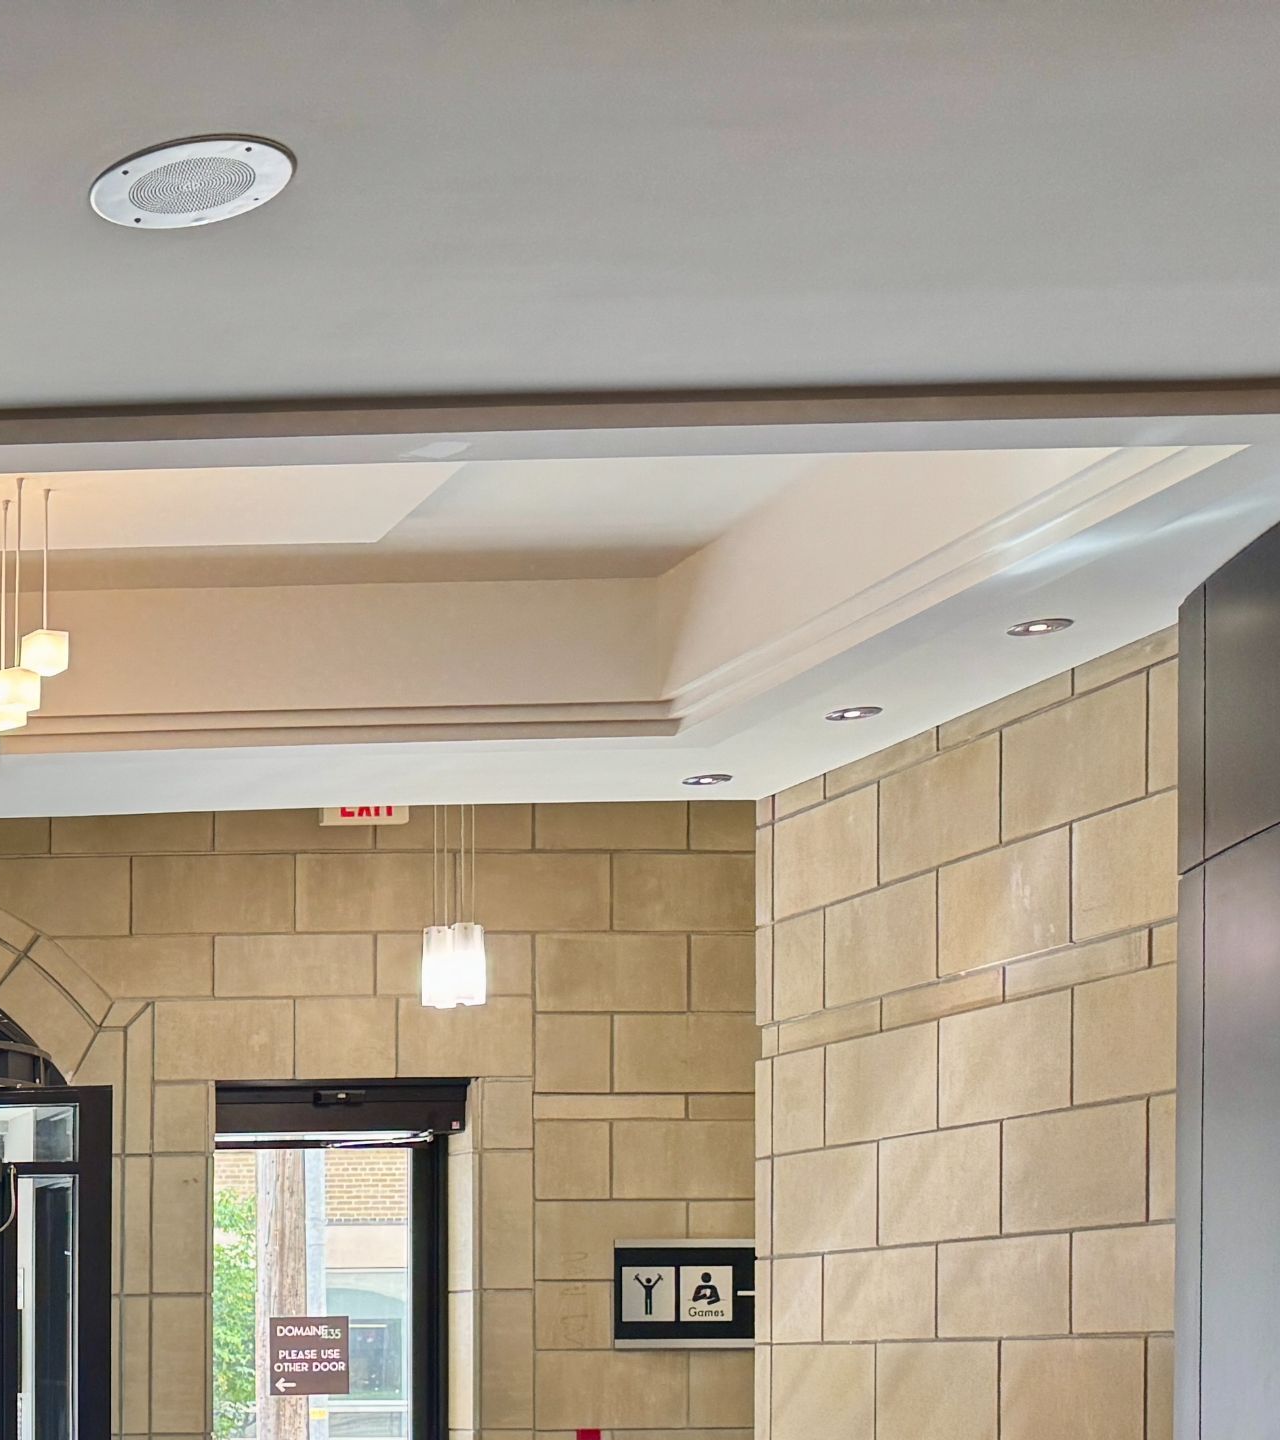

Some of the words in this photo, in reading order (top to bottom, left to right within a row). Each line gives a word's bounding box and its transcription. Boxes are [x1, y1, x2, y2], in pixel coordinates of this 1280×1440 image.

[688, 1306, 725, 1317] Games
[278, 1349, 317, 1360] PLEASE
[320, 1348, 341, 1359] USE
[273, 1362, 309, 1372] OTHER
[312, 1361, 346, 1372] DOOR
